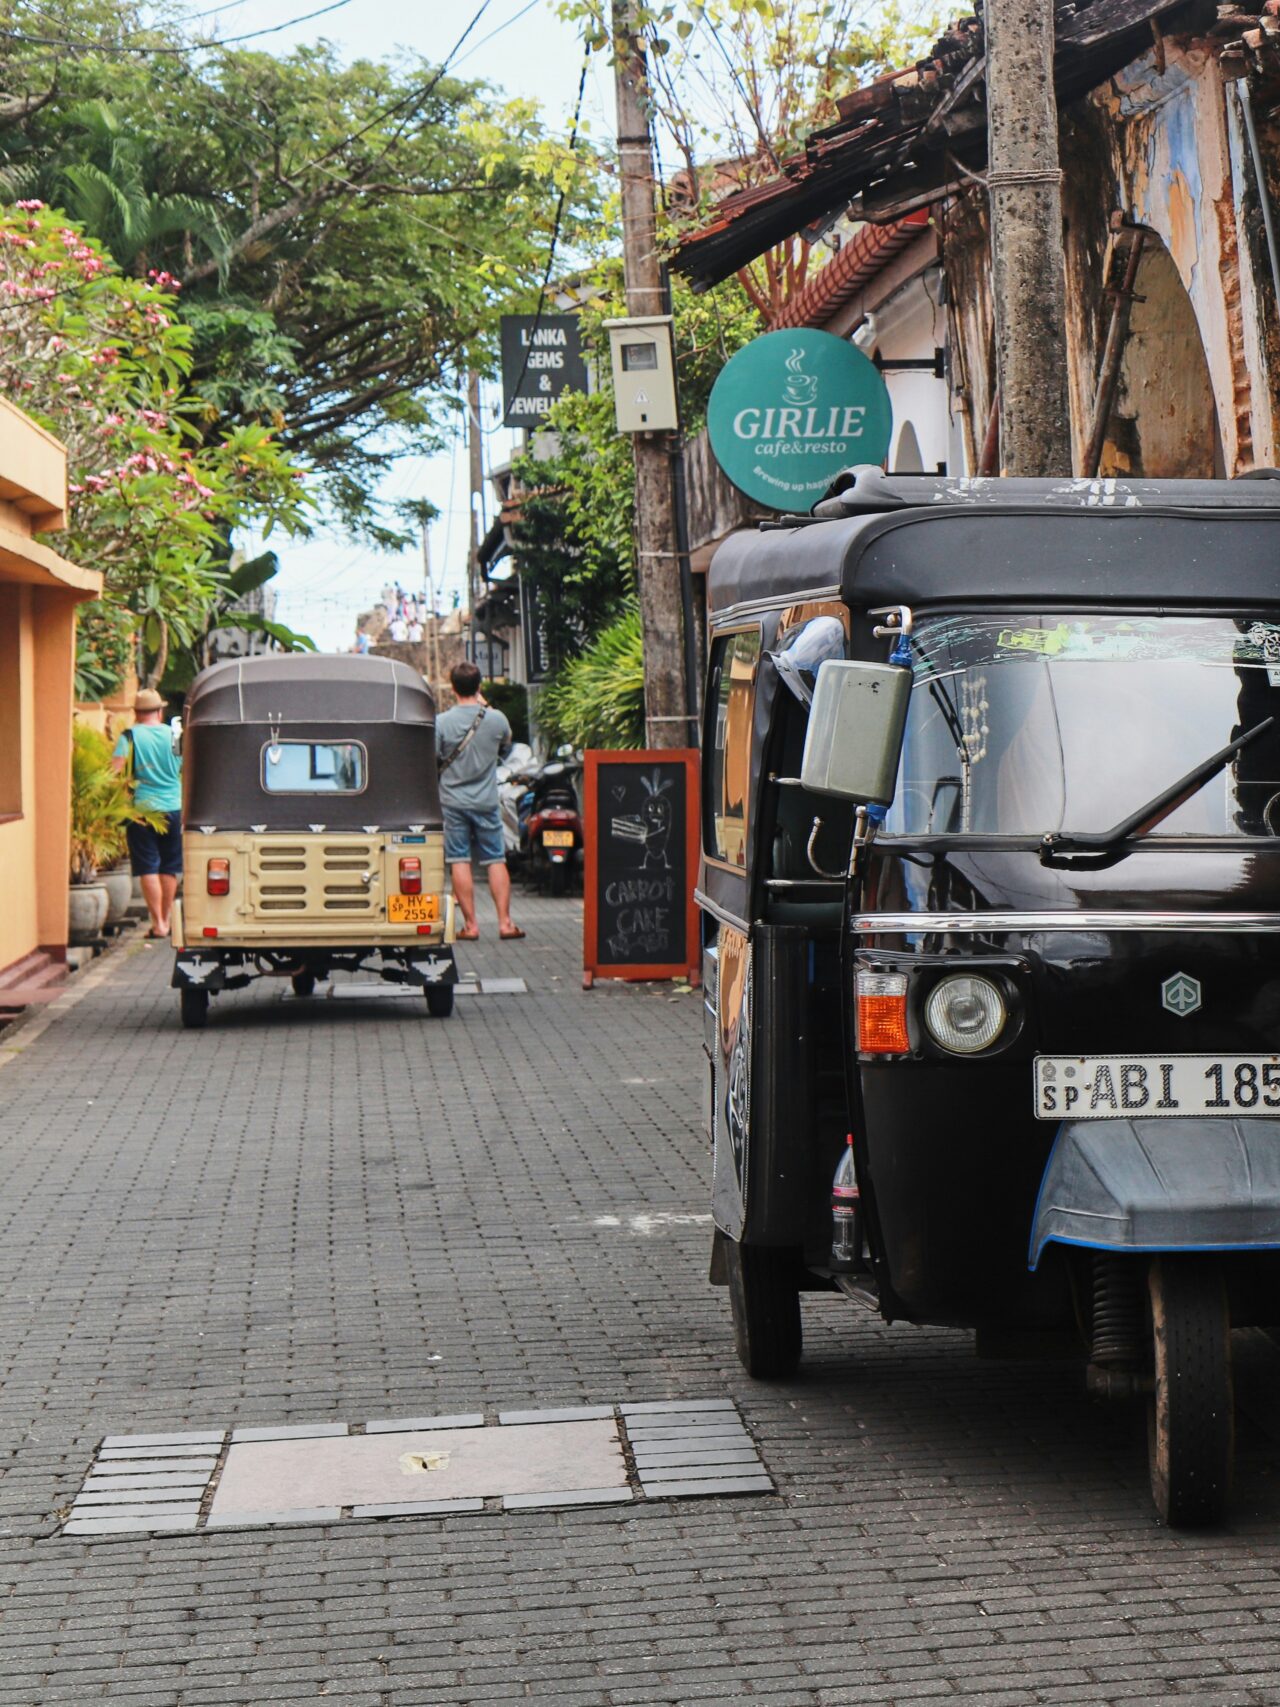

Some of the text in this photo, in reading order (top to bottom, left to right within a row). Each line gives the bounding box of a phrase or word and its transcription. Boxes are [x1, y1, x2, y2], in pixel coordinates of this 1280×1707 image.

[521, 328, 568, 346] LANKA
[527, 351, 564, 369] GEMS
[538, 374, 551, 391] &
[733, 406, 866, 439] GIRLIE
[755, 440, 847, 458] cafe&resto
[753, 465, 790, 491] Brewing
[791, 483, 805, 492] up
[404, 909, 434, 920] 2554
[616, 906, 670, 933] CAKE
[1089, 1063, 1180, 1109] ABI
